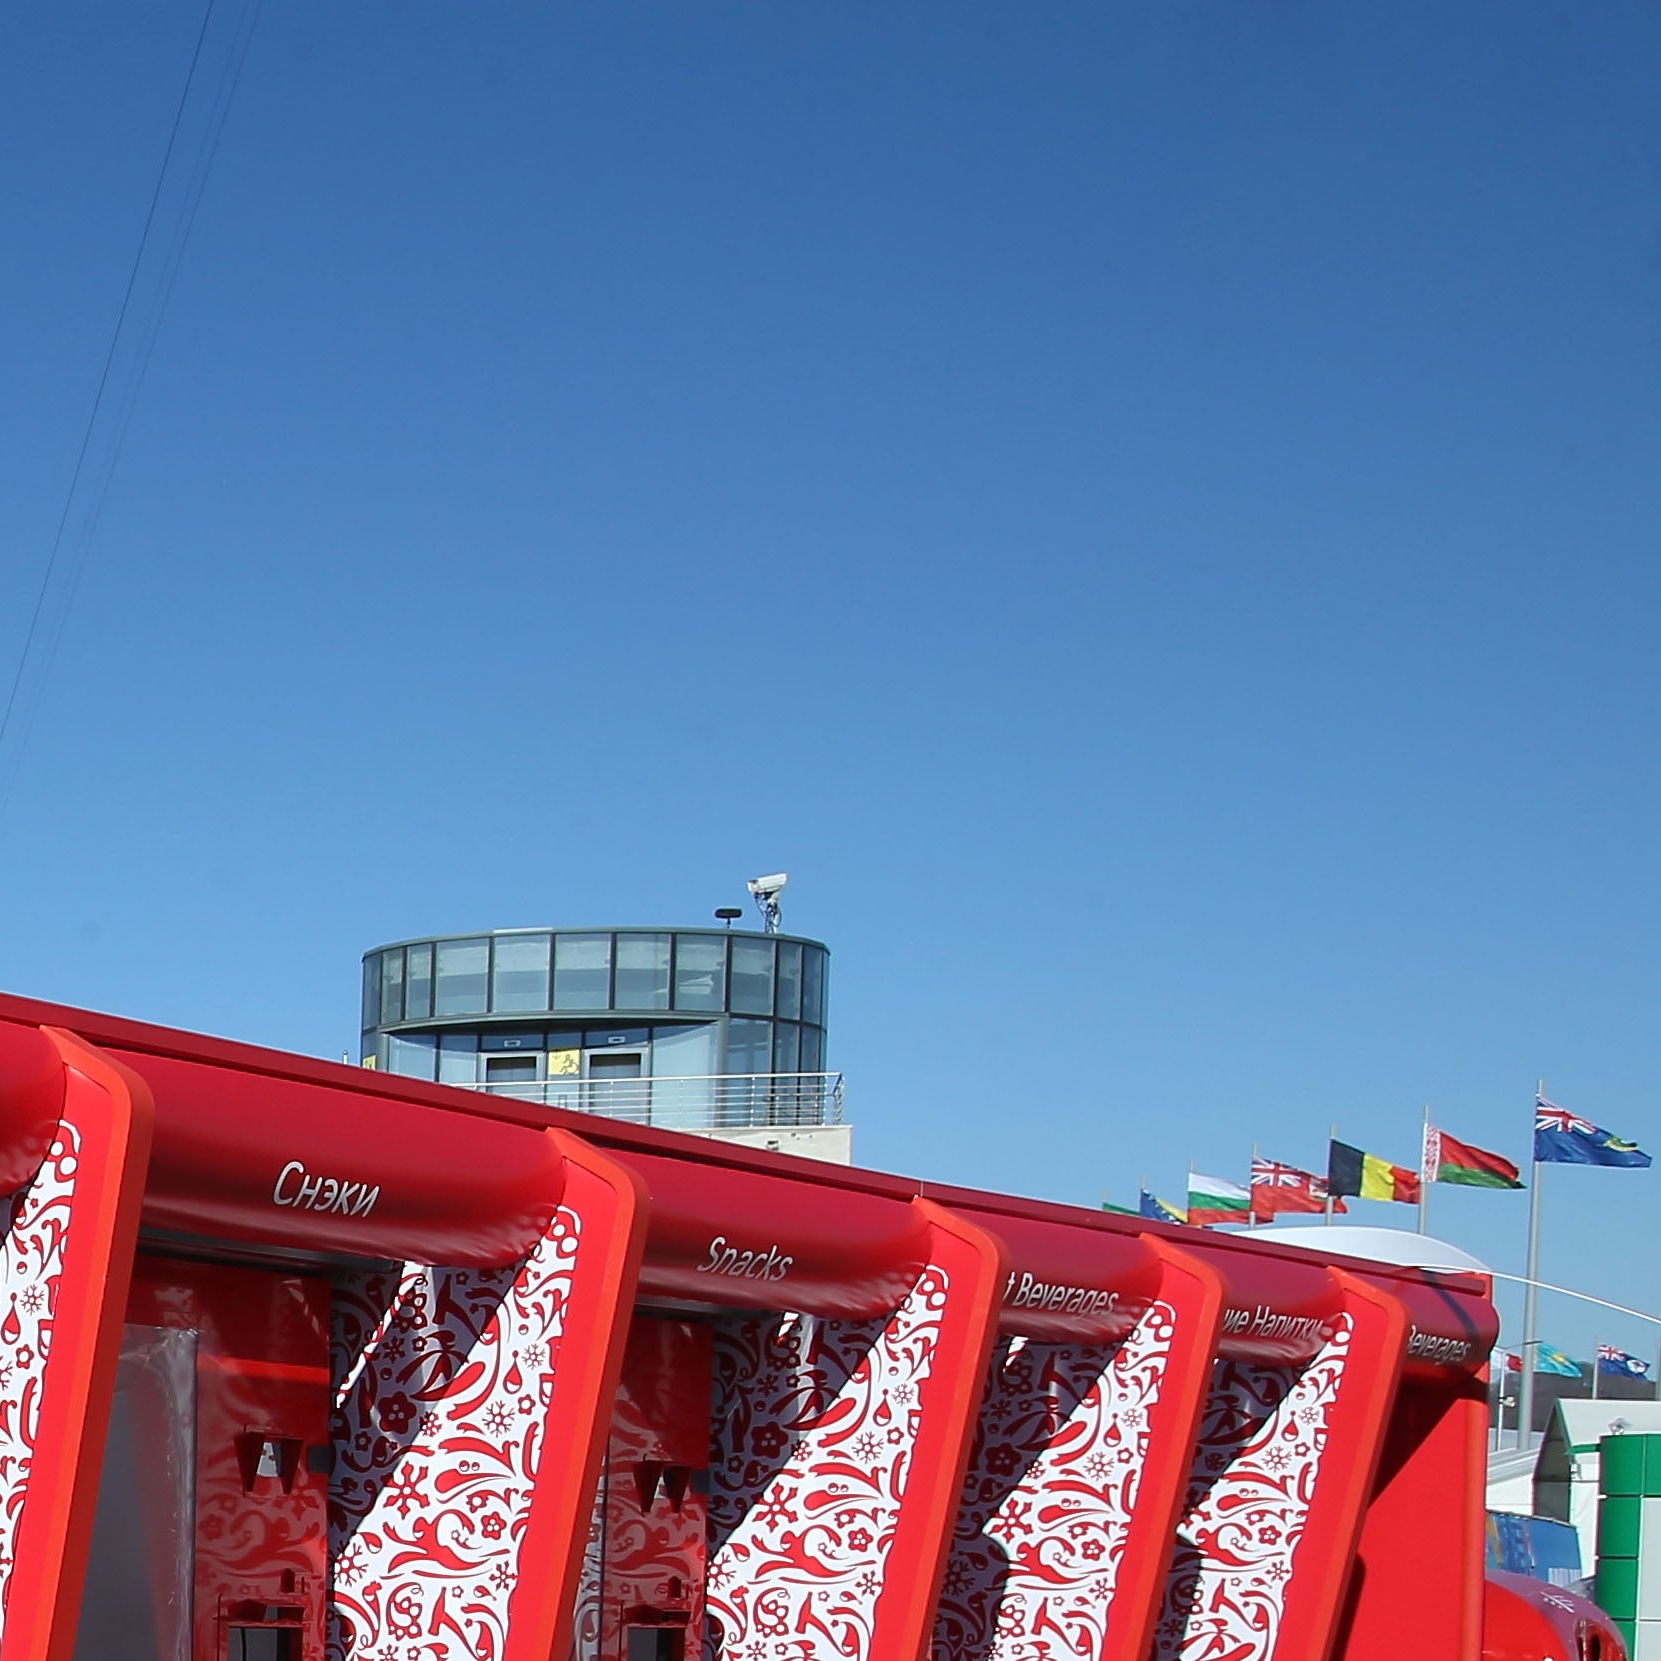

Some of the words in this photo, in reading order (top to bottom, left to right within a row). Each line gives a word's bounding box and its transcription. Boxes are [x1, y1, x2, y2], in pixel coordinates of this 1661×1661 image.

[696, 1236, 793, 1281] Snacks
[1011, 1272, 1119, 1319] Beverages
[1246, 1305, 1324, 1340] Напитки
